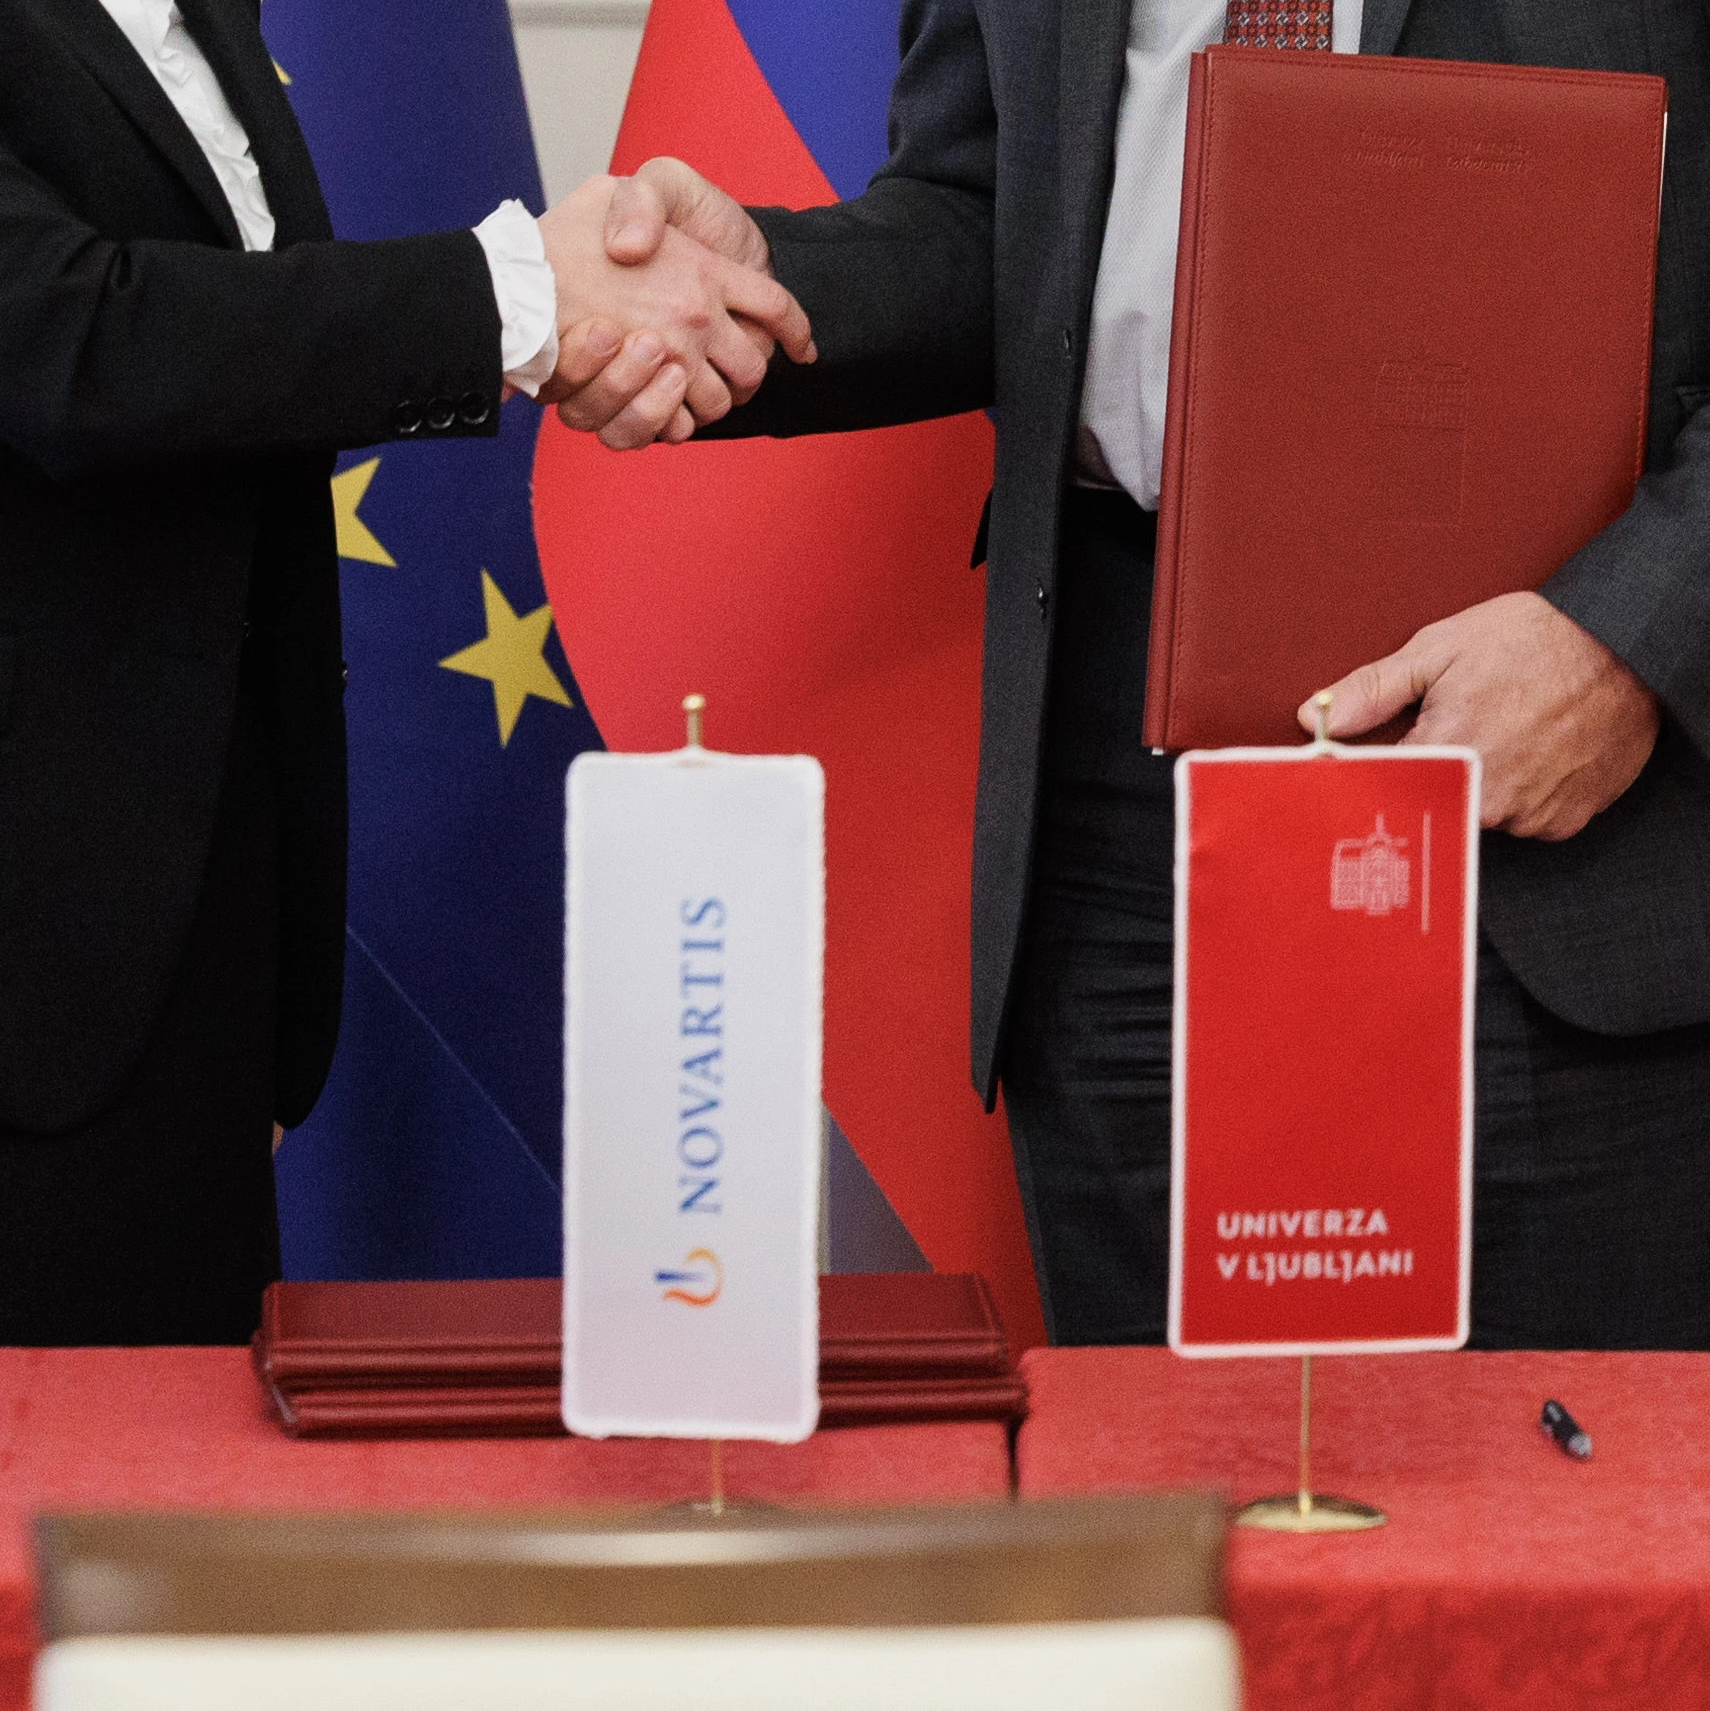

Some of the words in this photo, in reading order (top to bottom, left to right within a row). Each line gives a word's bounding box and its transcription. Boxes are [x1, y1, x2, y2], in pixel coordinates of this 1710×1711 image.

[678, 896, 726, 1214] NOVARTIS
[1216, 1208, 1388, 1240] UNIVERZA
[1215, 1253, 1239, 1280] V
[1246, 1250, 1414, 1286] LJUBLJANI
